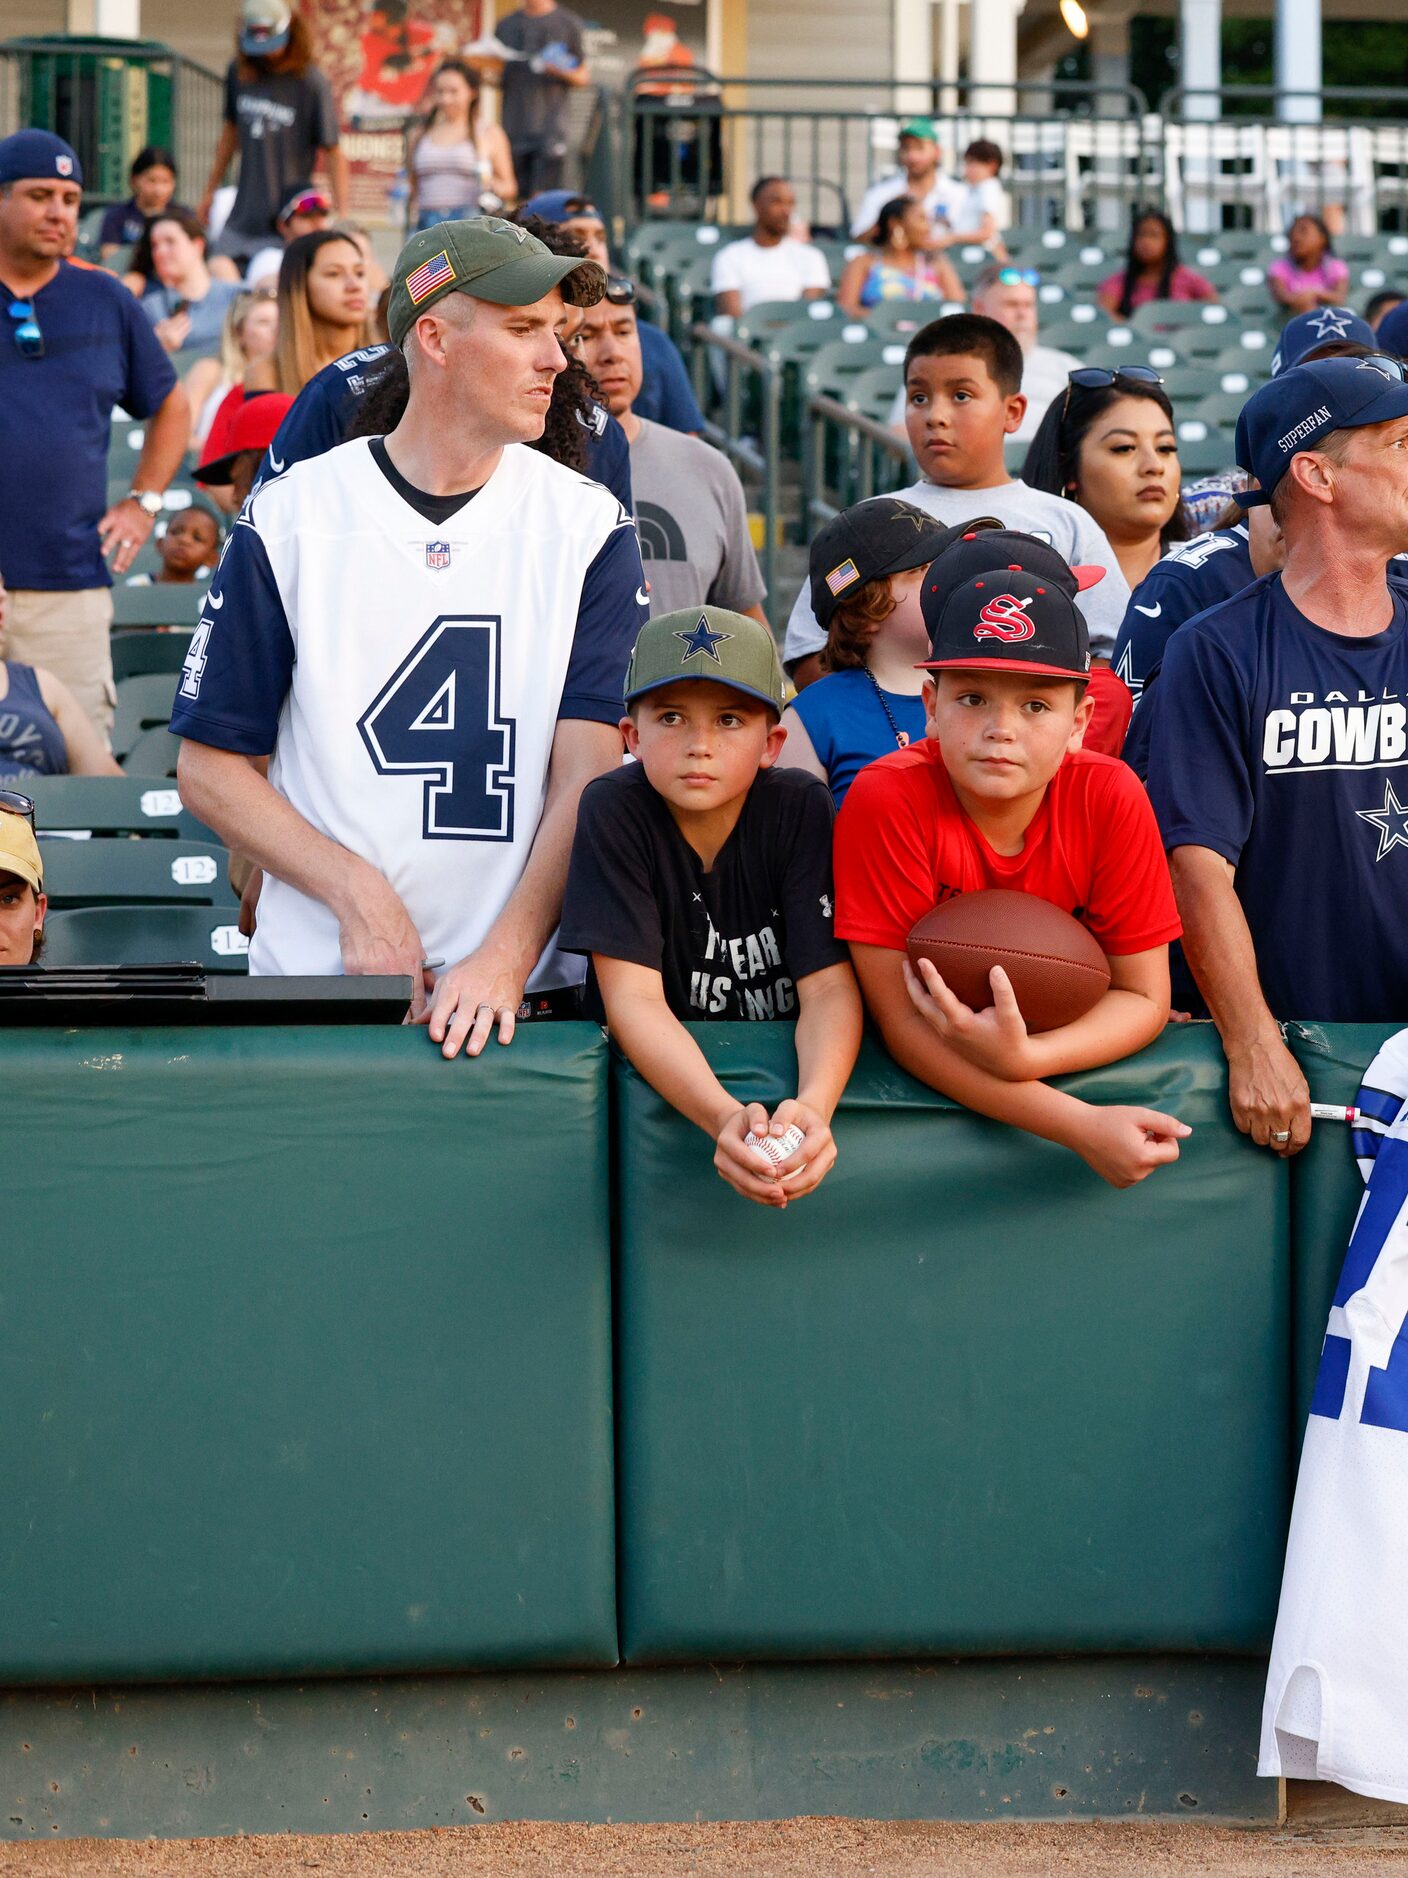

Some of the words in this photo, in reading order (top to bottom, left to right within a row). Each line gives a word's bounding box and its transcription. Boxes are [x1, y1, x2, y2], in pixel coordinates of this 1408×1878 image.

[1277, 405, 1333, 453] SUPERFAN
[428, 553, 449, 566] NFL
[179, 617, 214, 700] 4
[356, 614, 516, 842] 4
[184, 862, 206, 879] 12
[690, 971, 732, 1013] US
